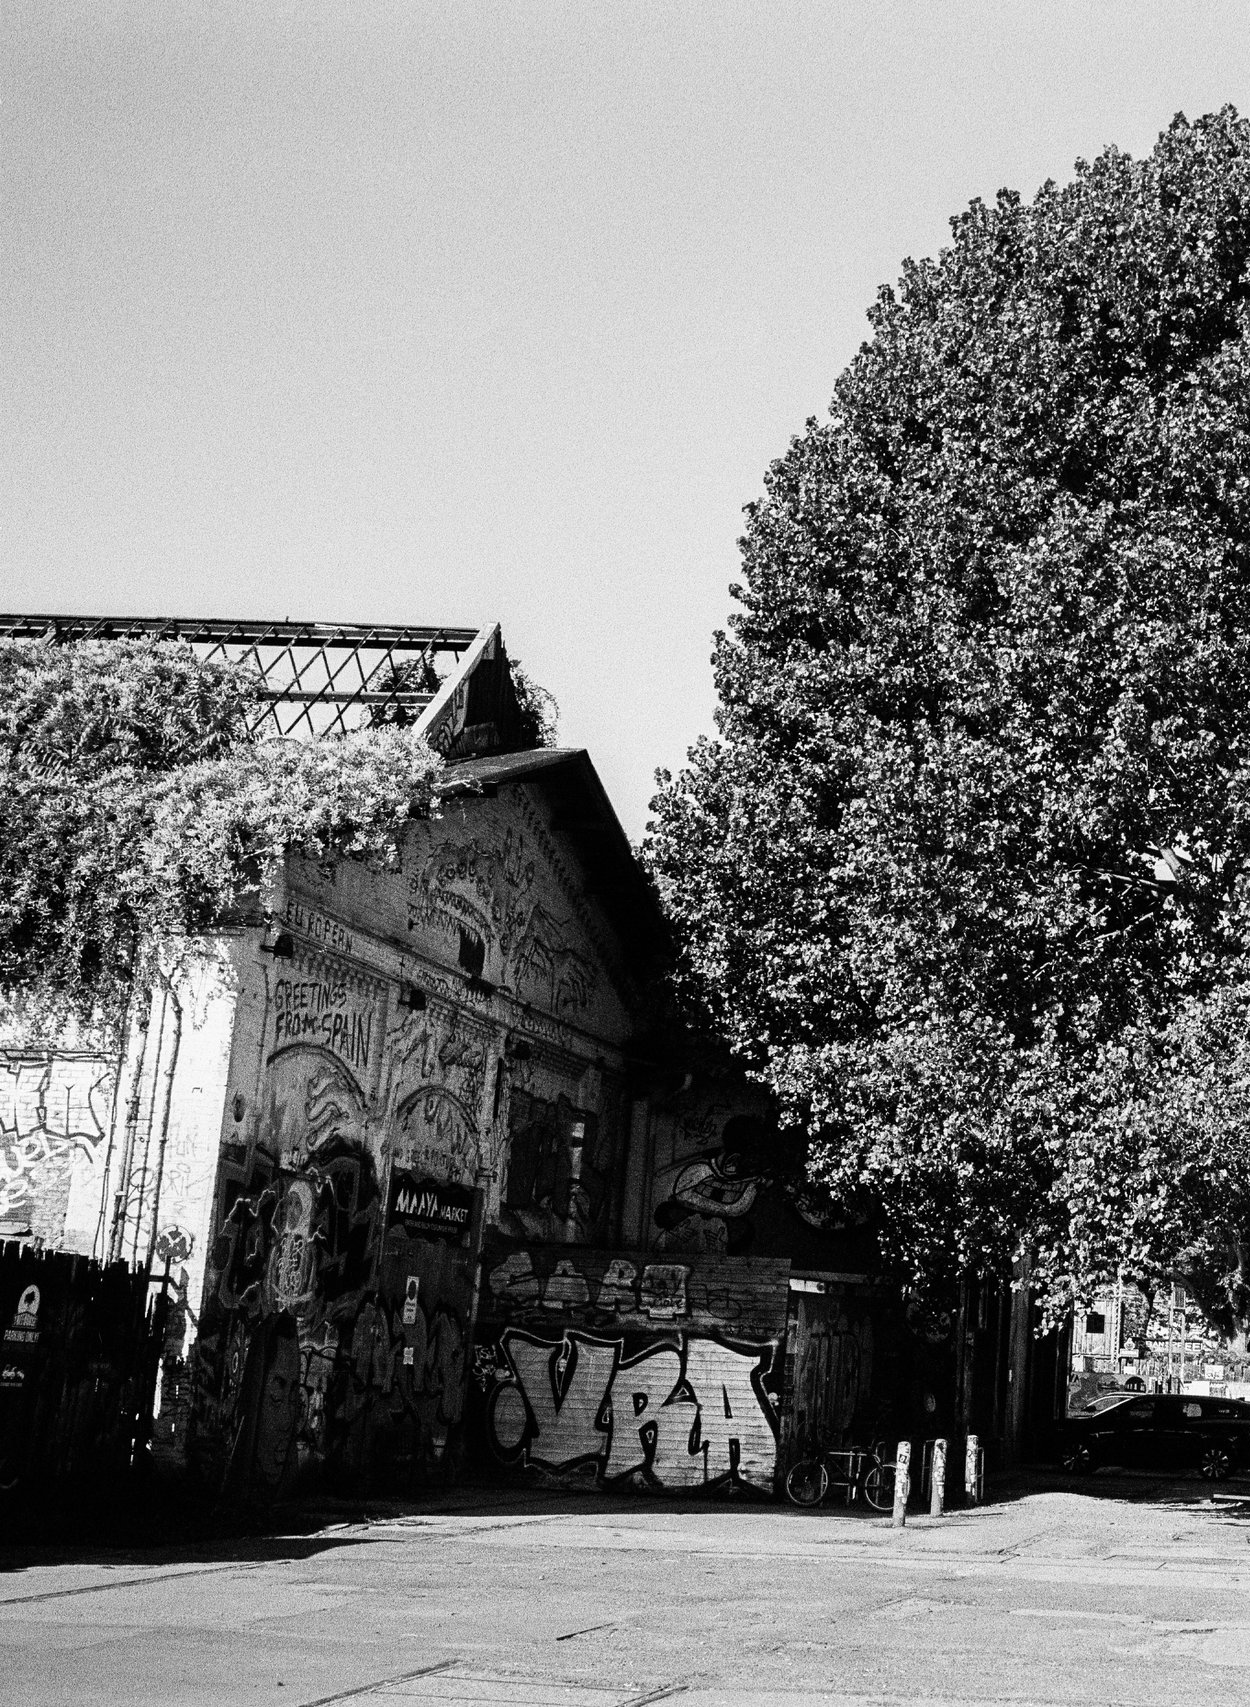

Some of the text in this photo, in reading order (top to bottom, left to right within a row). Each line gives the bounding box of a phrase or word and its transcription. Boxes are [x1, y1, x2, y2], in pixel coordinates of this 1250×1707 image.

[275, 978, 347, 1011] GREETINGS
[275, 1010, 372, 1067] FROM SPAIN
[395, 1188, 469, 1223] MAAYA MARKET
